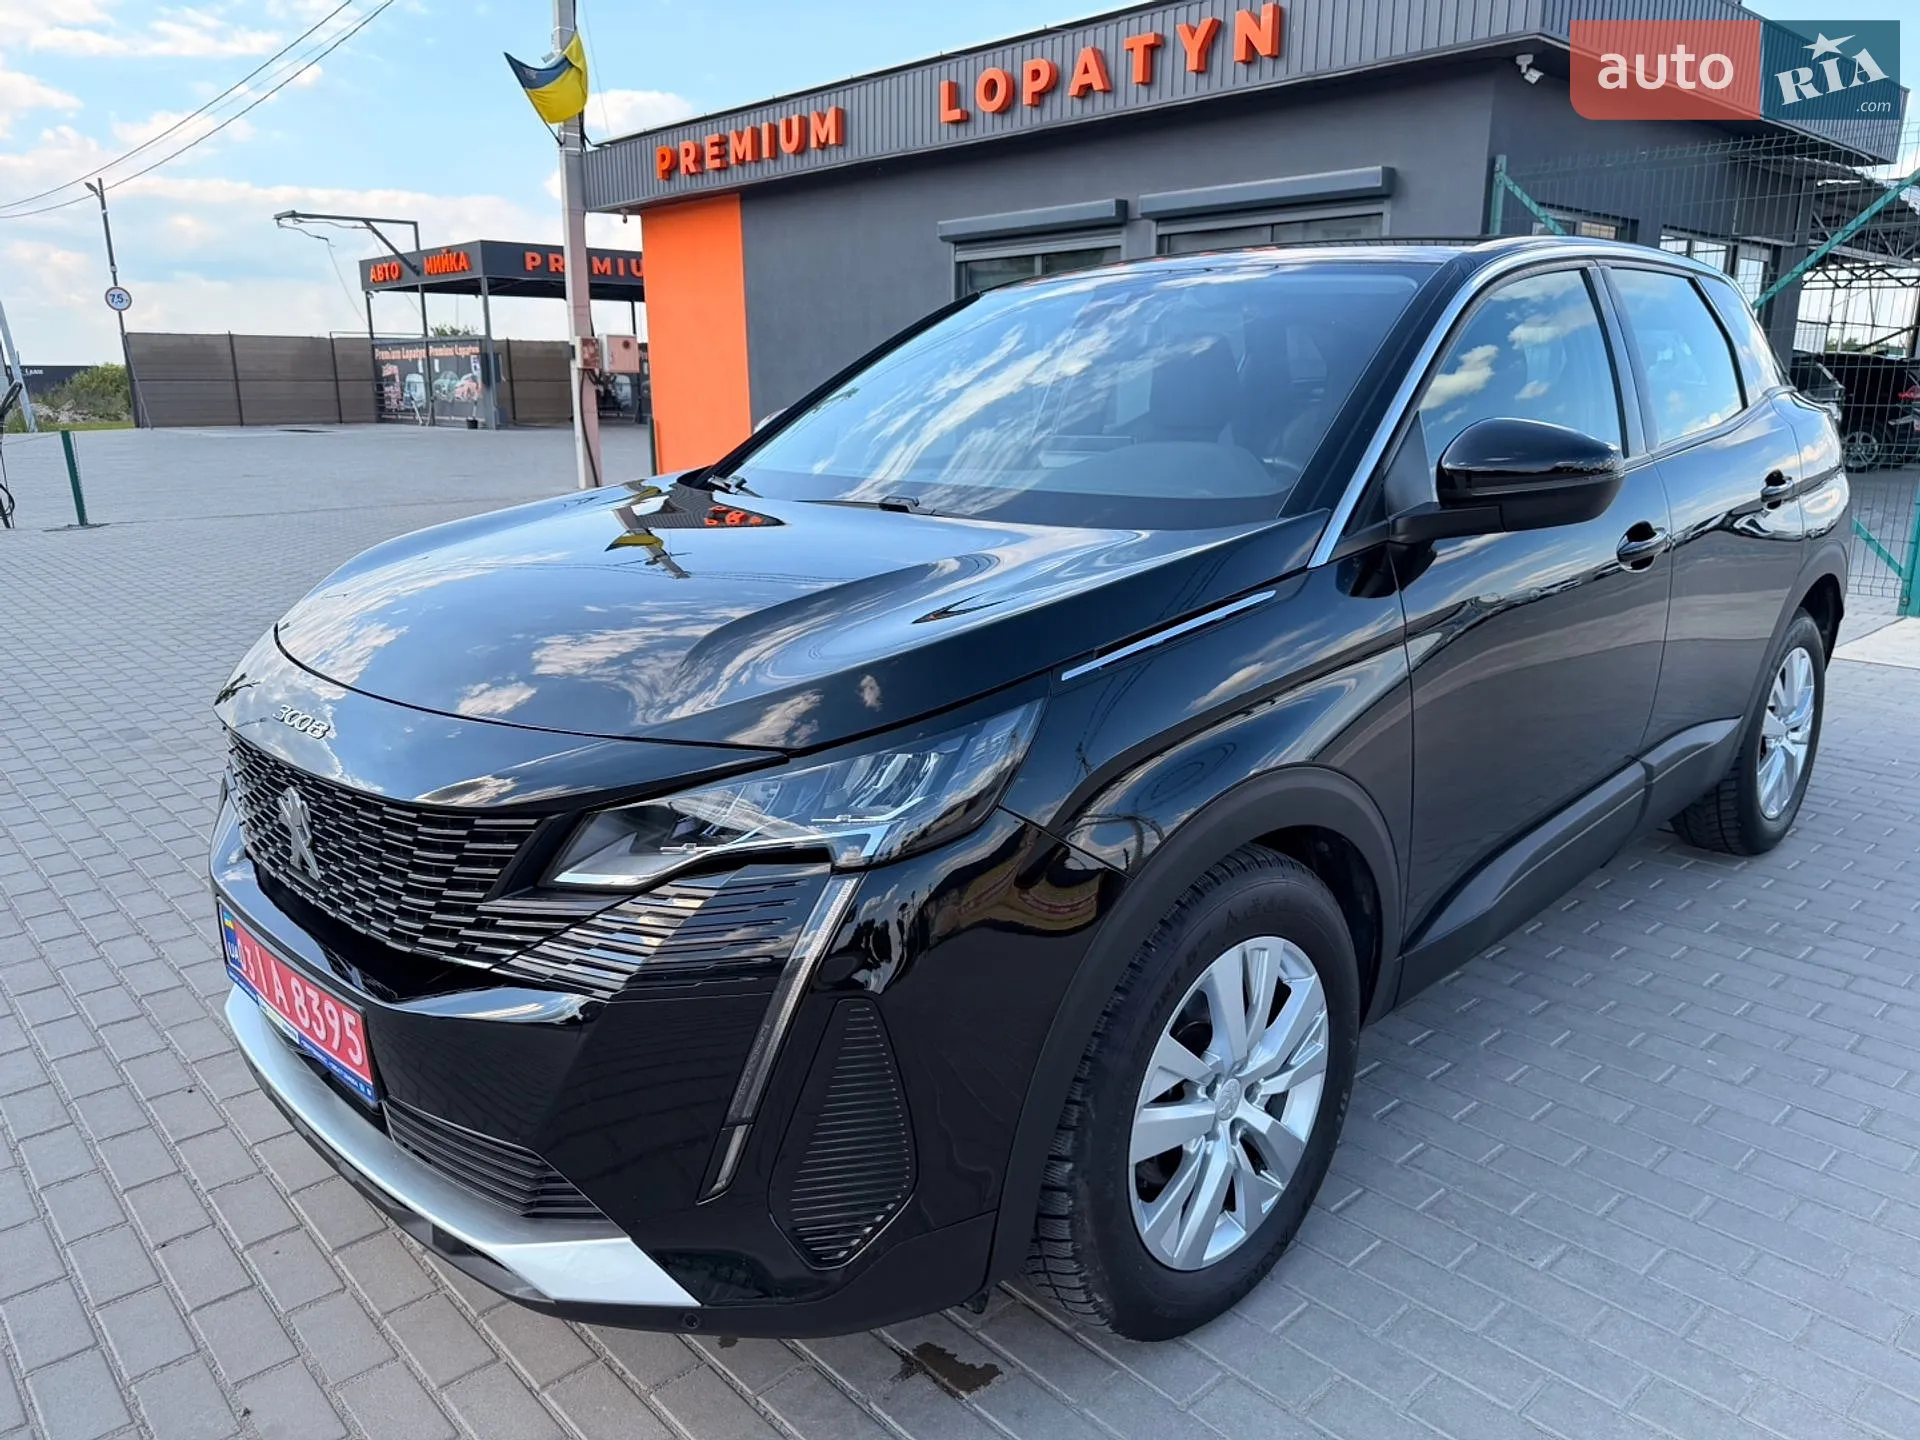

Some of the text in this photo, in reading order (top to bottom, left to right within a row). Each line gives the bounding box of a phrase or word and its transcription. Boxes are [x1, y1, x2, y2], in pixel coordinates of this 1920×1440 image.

[656, 2, 1282, 180] PREMIUM LOPATYN
[370, 249, 470, 282] АВТО МИЙКА
[524, 251, 643, 277] PRMIU
[272, 704, 330, 739] 3008
[227, 941, 240, 960] UA
[290, 976, 364, 1066] 8395
